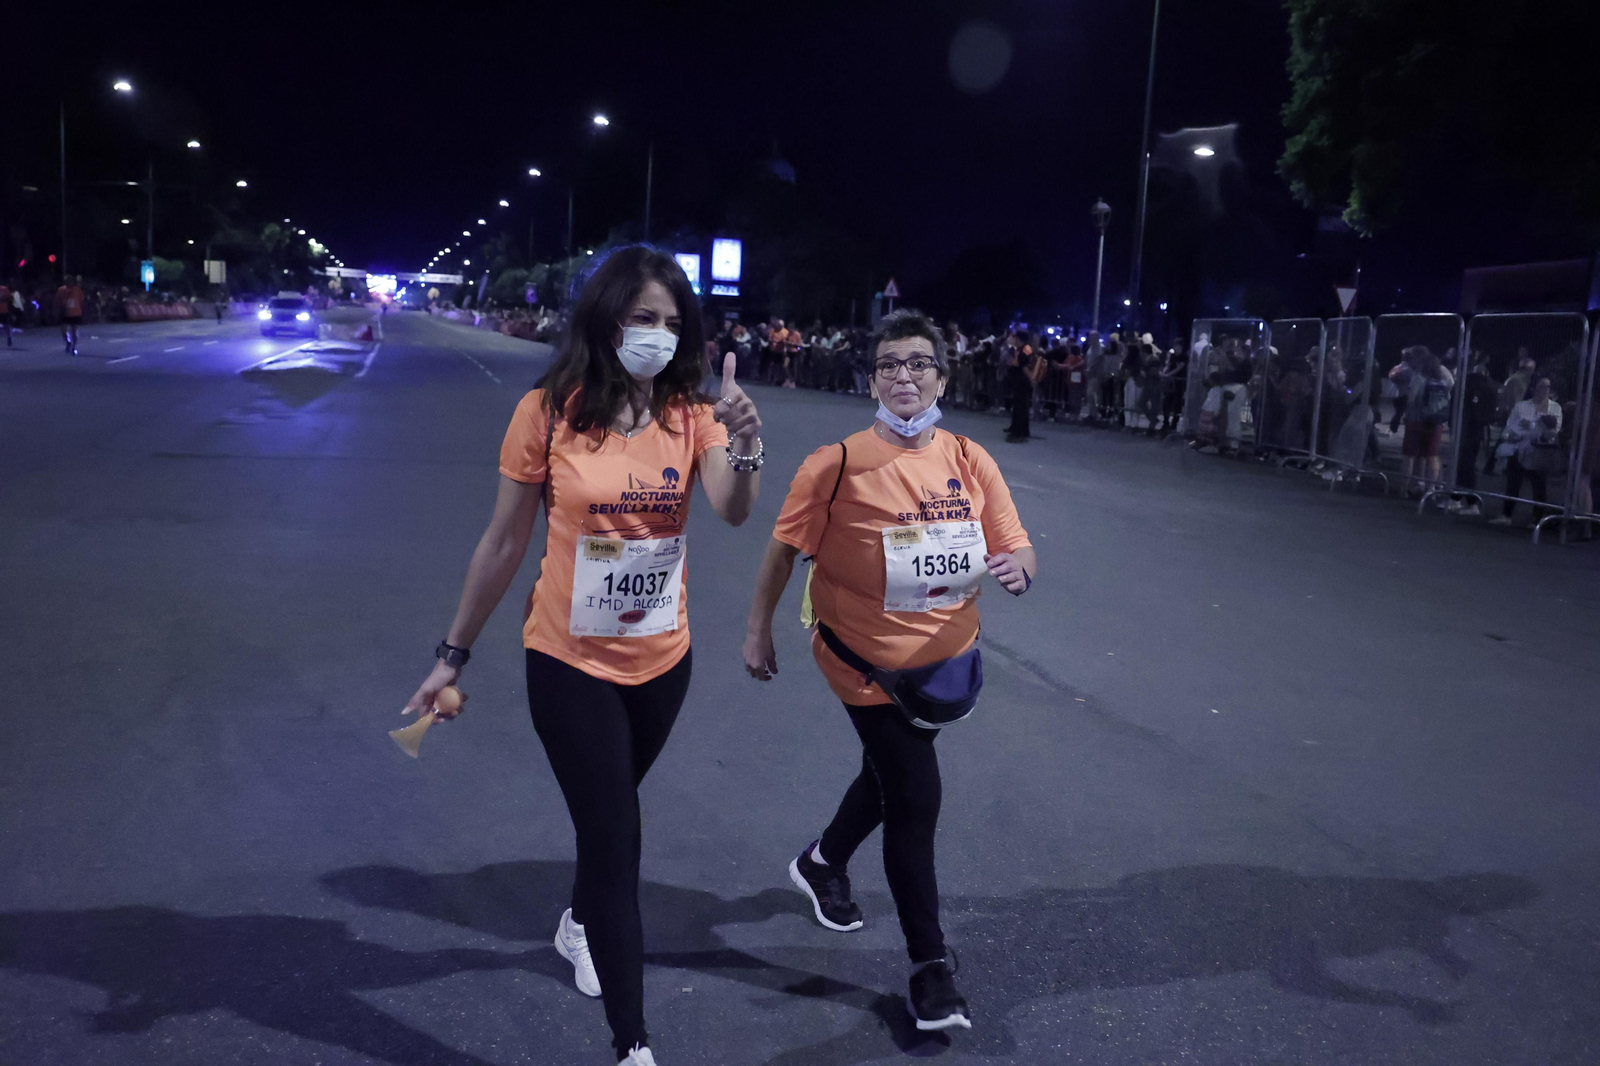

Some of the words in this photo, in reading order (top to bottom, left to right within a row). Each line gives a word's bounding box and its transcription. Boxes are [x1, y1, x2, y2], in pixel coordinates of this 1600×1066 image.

[620, 491, 684, 502] NOCTURNA
[589, 503, 650, 514] SEVILLA
[919, 499, 971, 510] NOCTURNA
[898, 510, 944, 521] SEVILLA
[911, 552, 971, 577] 15364
[604, 571, 668, 596] 14037
[585, 595, 624, 611] IMD
[633, 595, 673, 610] ALCOSA
